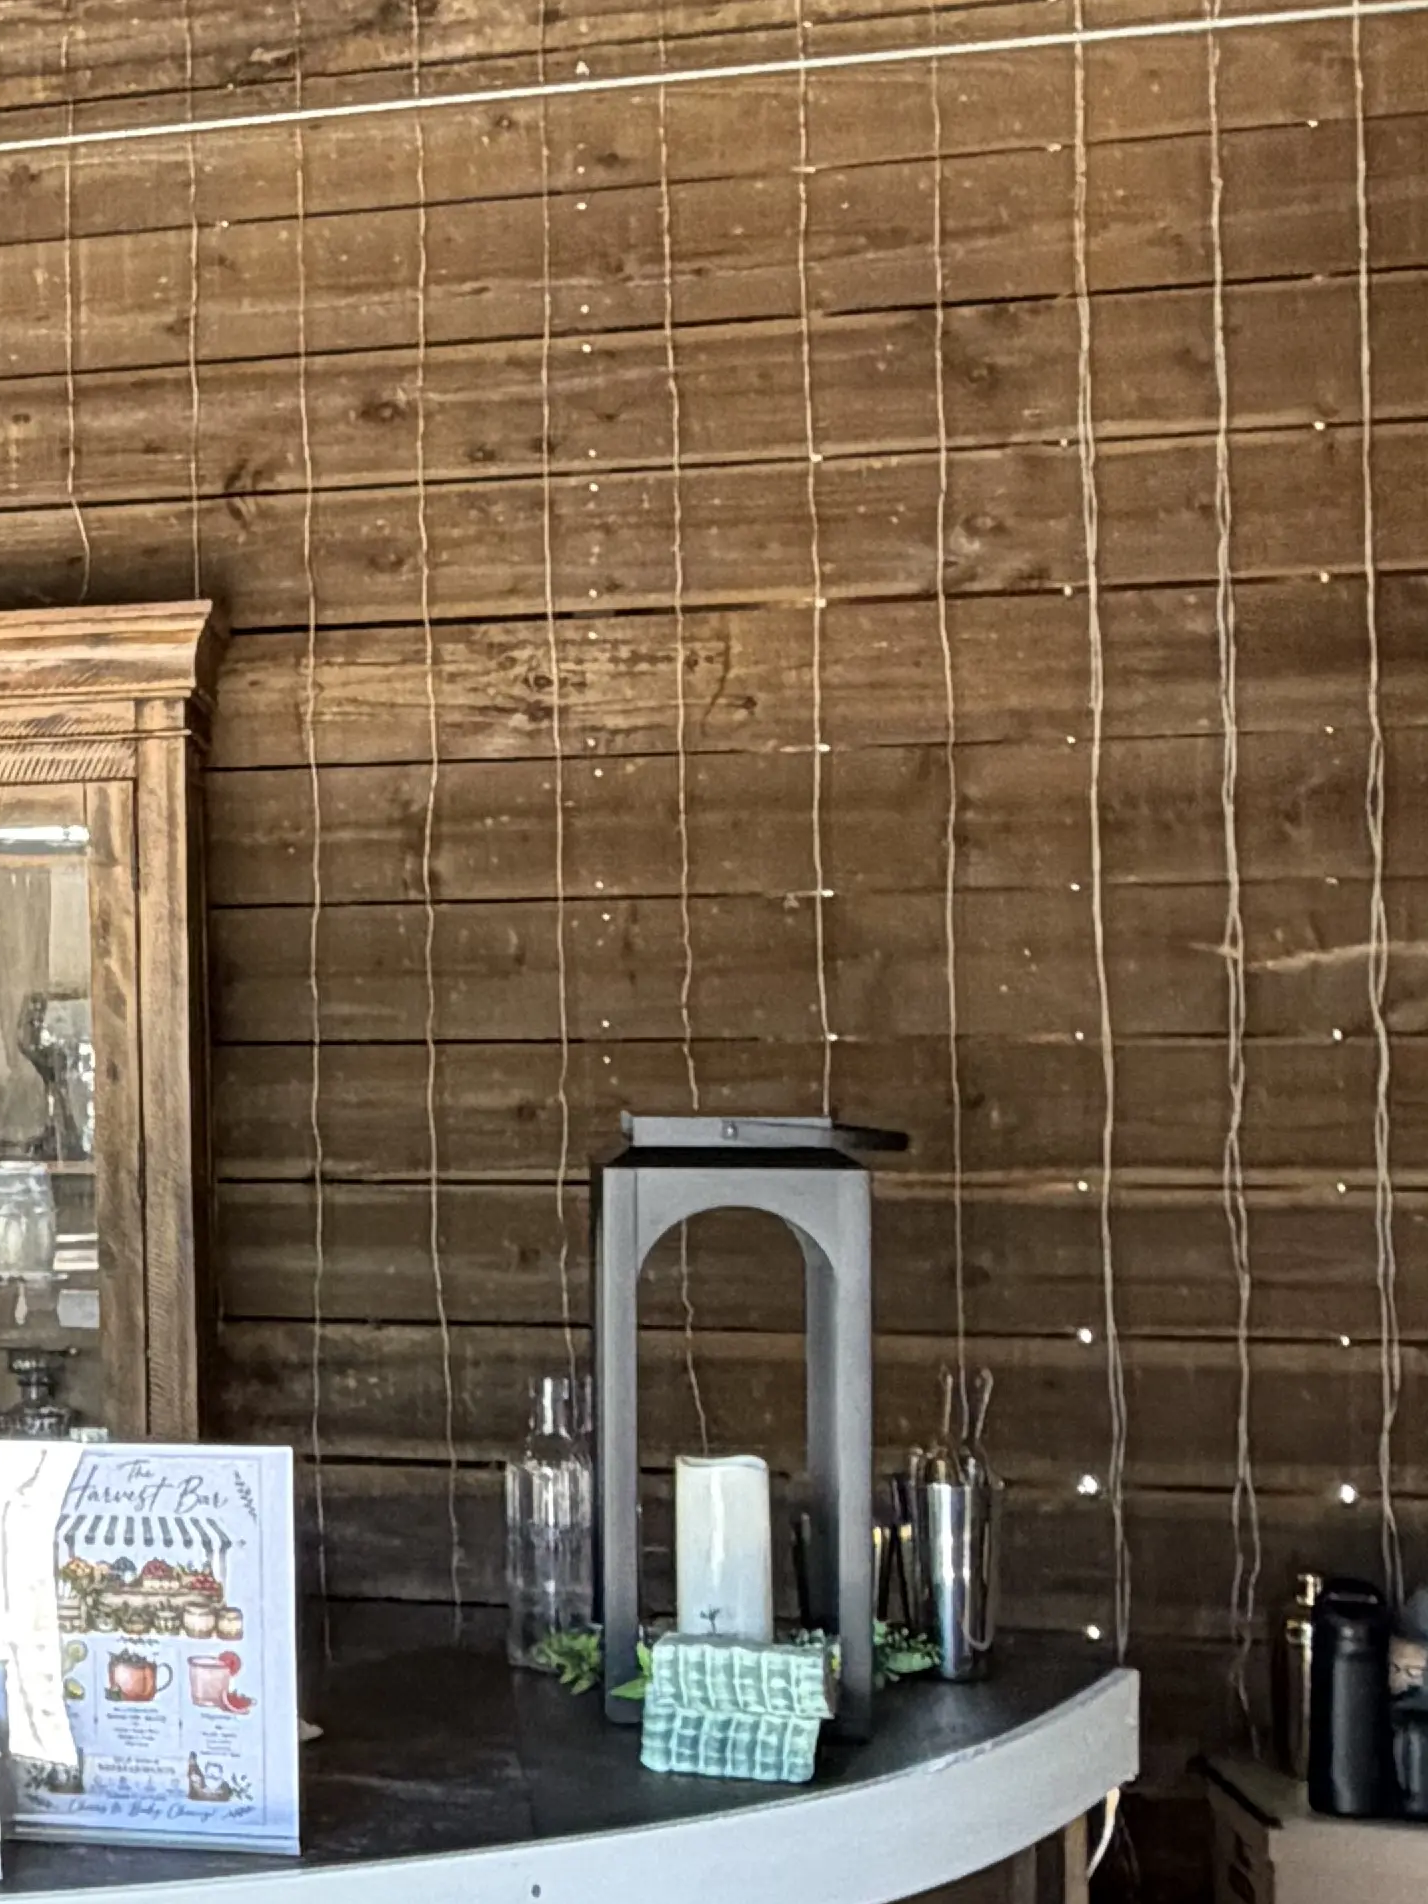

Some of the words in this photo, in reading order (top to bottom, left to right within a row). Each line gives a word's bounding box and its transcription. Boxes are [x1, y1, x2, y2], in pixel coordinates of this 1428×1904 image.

[62, 1463, 174, 1513] Harvest
[174, 1474, 228, 1514] Bar
[116, 1459, 154, 1482] The
